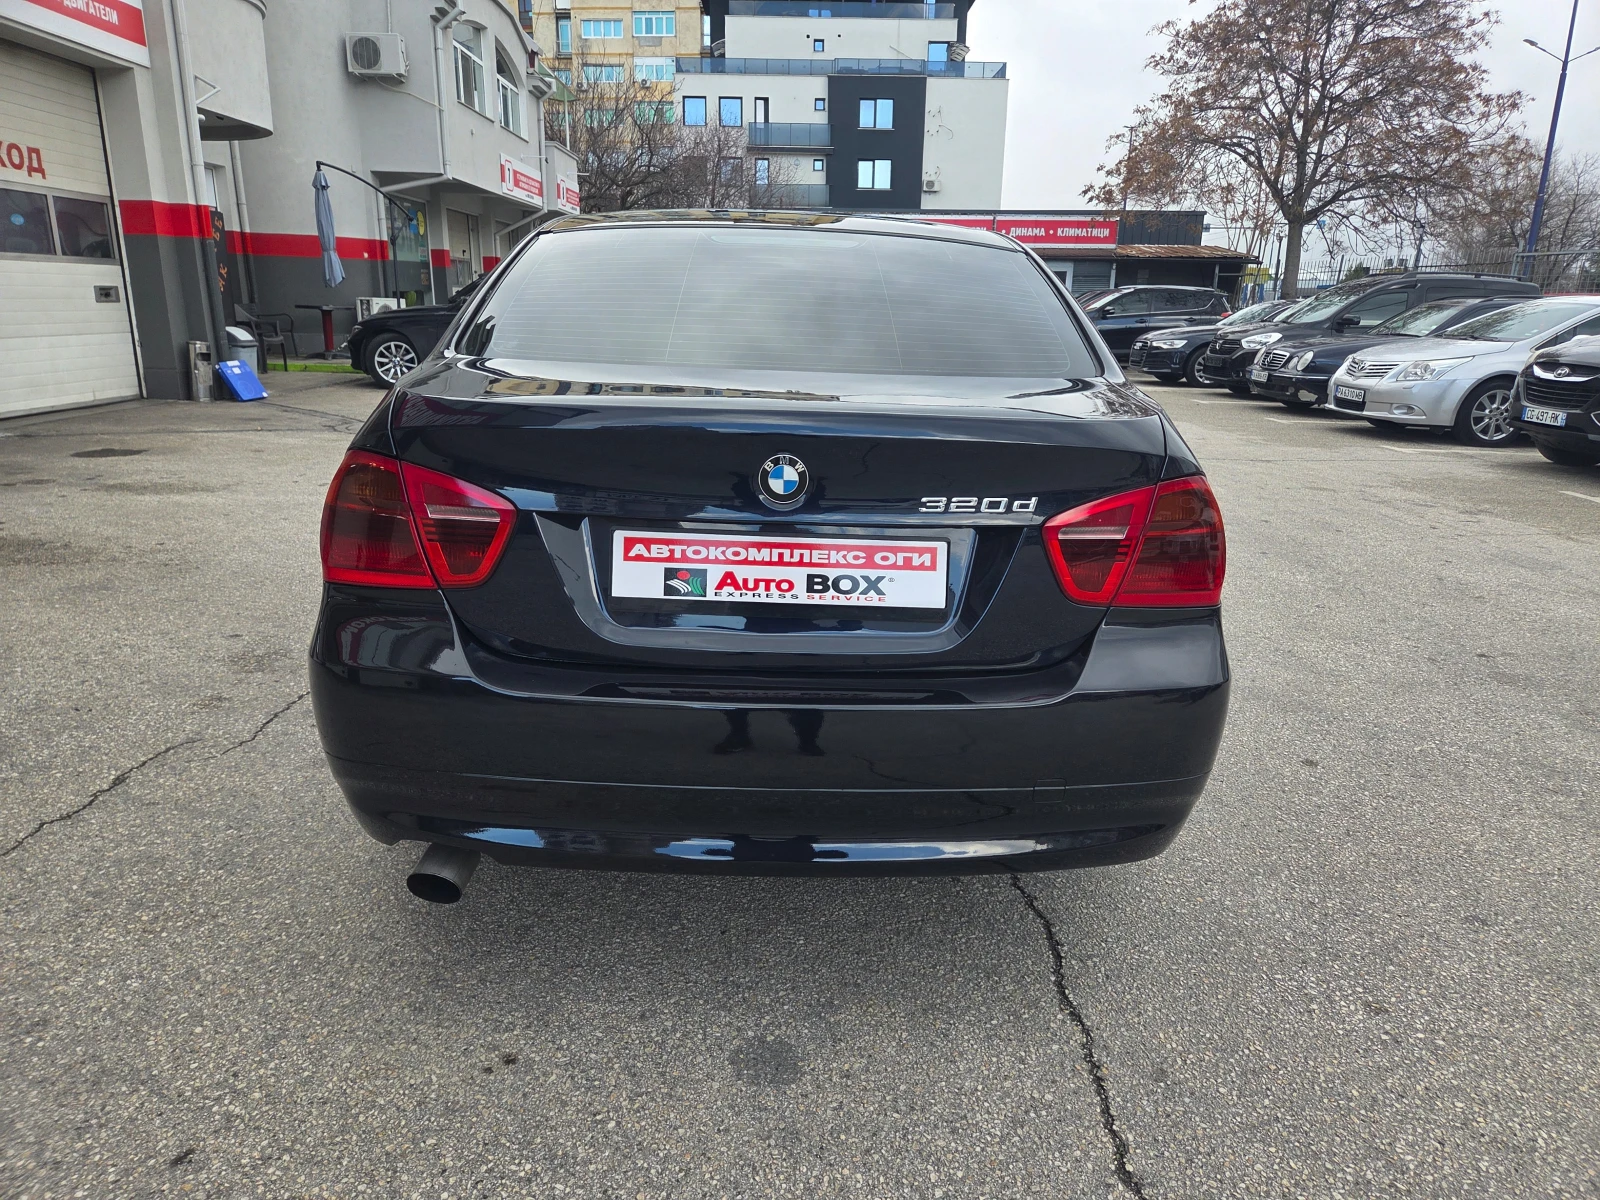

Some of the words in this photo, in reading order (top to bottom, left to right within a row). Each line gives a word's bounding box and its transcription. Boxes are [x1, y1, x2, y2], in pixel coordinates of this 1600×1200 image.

[1009, 227, 1046, 237] ДИНАМА
[1057, 227, 1110, 238] КЛИМАТИЦИ
[764, 456, 805, 473] BMW
[918, 496, 1039, 513] 320d
[628, 543, 866, 564] АВТОКОМПЛЕКС
[874, 551, 931, 566] ОГИ
[807, 594, 886, 602] SERVICE
